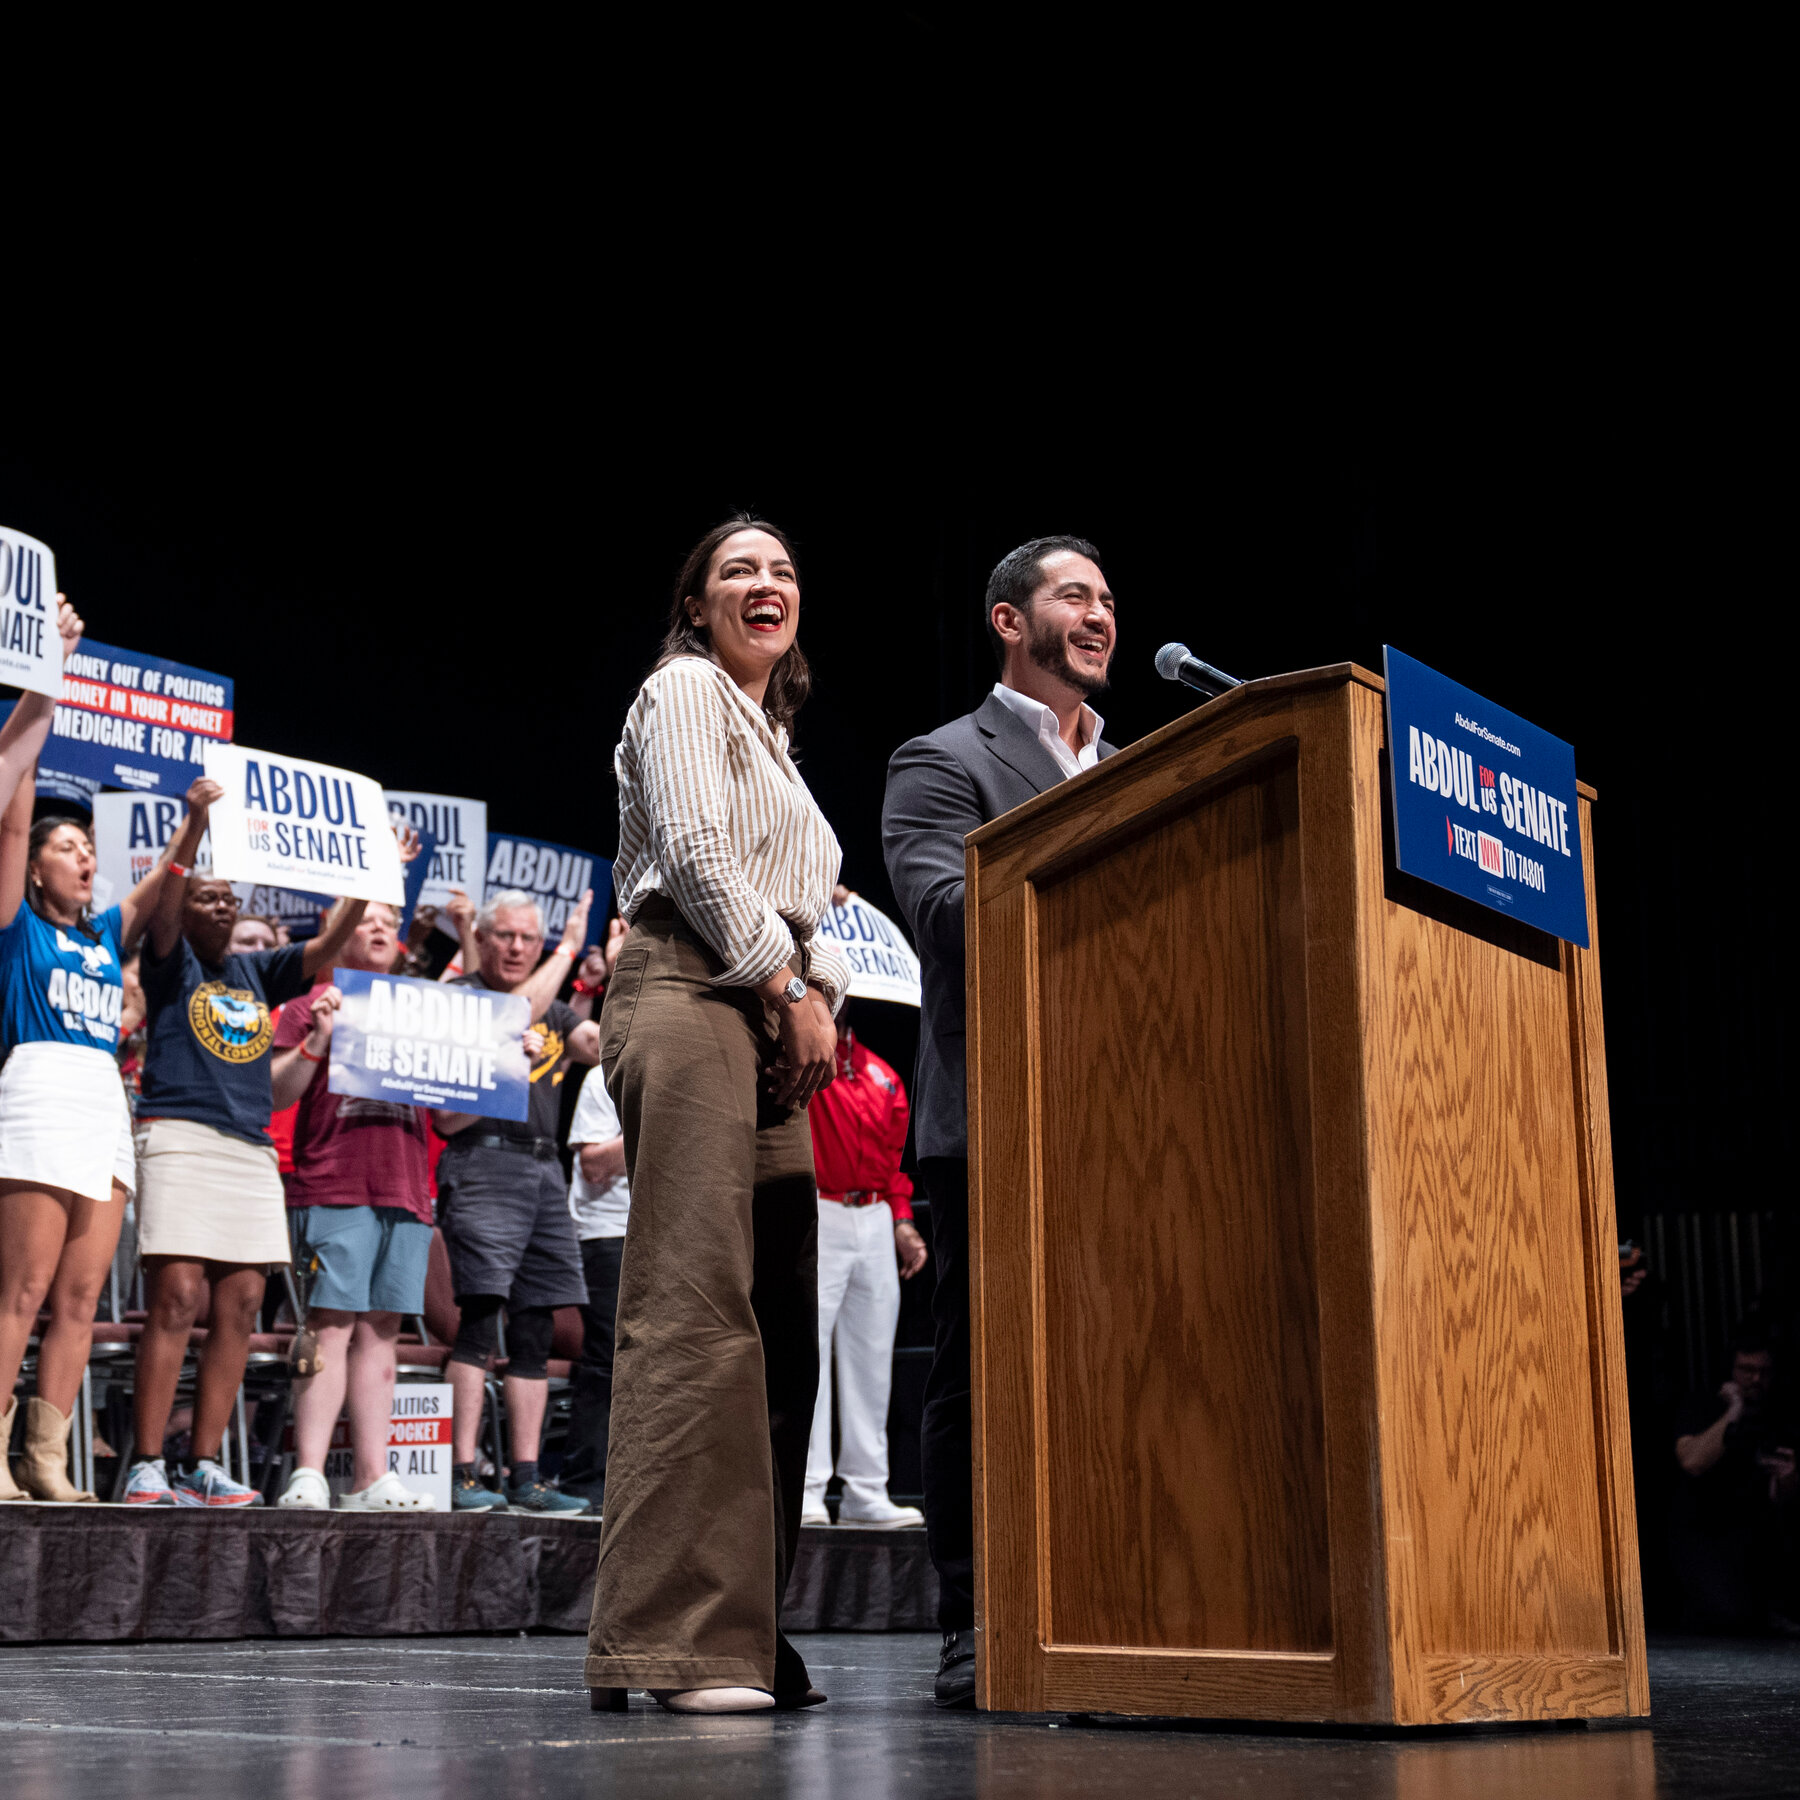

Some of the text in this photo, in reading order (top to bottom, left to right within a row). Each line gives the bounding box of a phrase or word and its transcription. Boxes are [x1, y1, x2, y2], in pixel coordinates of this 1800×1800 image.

[111, 662, 141, 689] OUT
[142, 669, 162, 693] OF
[164, 674, 224, 708] POLITICS
[53, 706, 146, 753] MEDICARE
[151, 727, 186, 762] FOR
[110, 690, 127, 713] IN
[130, 693, 168, 722] YOUR
[171, 703, 223, 733] POCKET
[1455, 712, 1521, 758] AbdulForSenate.com
[245, 759, 366, 830] ABDUL
[1409, 725, 1571, 858] ABDUL FOR US SENATE
[247, 817, 269, 833] FOR
[249, 821, 370, 871] US SENATE
[1453, 823, 1546, 894] TEXT WIN TO 74801
[846, 946, 919, 985] SENATE
[366, 979, 499, 1049] ABDUL
[365, 1038, 498, 1091] US SENATE
[387, 1421, 440, 1443] POCKET
[408, 1449, 438, 1475] ALL
